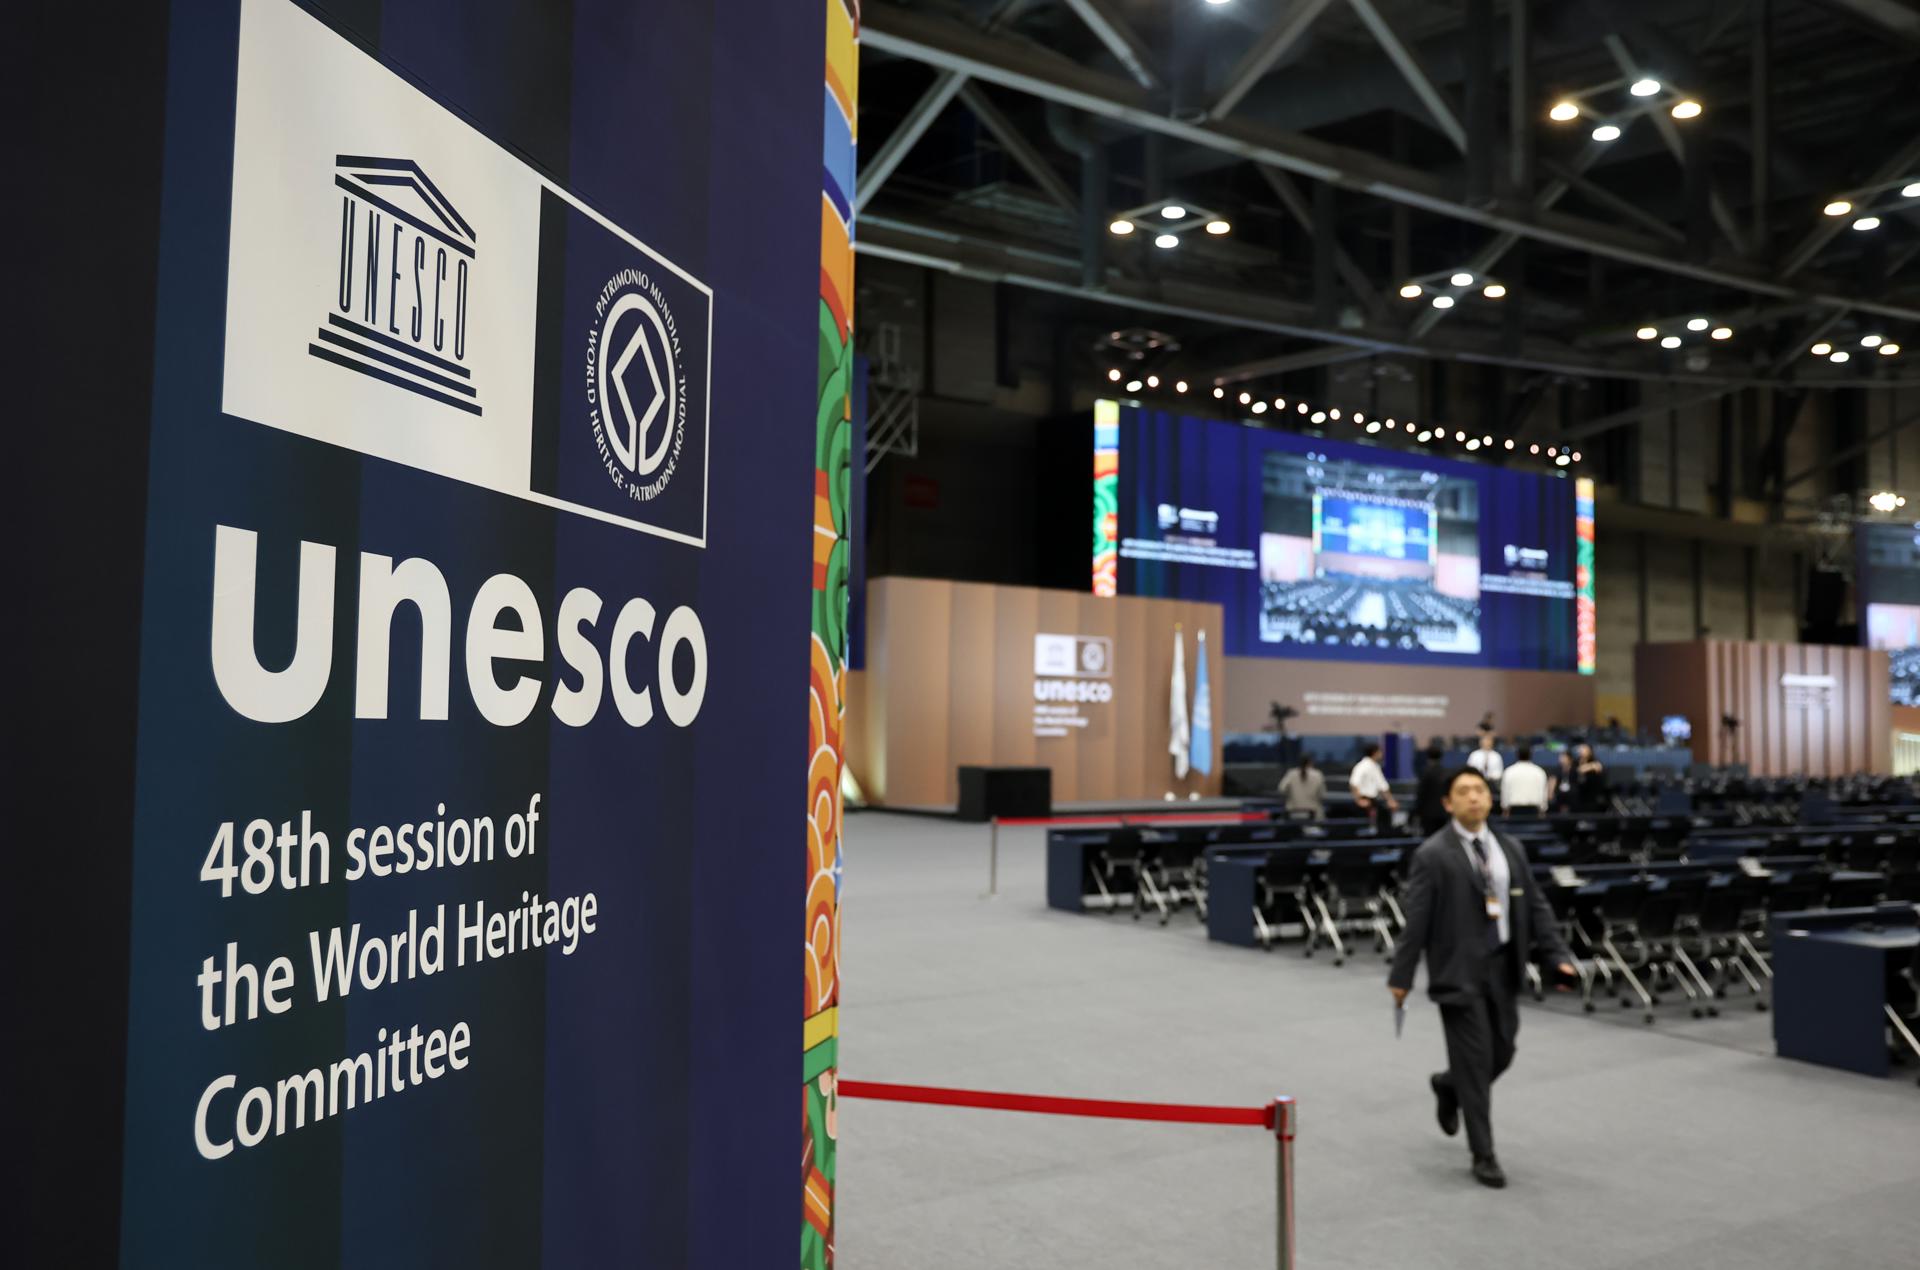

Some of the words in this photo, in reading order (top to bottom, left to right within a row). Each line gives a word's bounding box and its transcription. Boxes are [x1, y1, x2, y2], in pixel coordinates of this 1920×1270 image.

[338, 196, 468, 361] UNESCO
[595, 268, 649, 318] PATRIMONIO
[650, 282, 682, 359] MUNDIAL
[586, 329, 598, 404] WORLD
[589, 409, 623, 489] HERITAGE
[629, 457, 677, 501] PATRIMOINE
[674, 375, 687, 461] MONDIAL
[211, 524, 708, 728] unesco
[199, 809, 330, 898] 48th
[345, 802, 495, 881] session
[504, 792, 541, 858] of
[197, 942, 295, 1031] the
[309, 904, 445, 1003] World
[457, 892, 598, 967] Heritage
[194, 1021, 471, 1160] Committee
